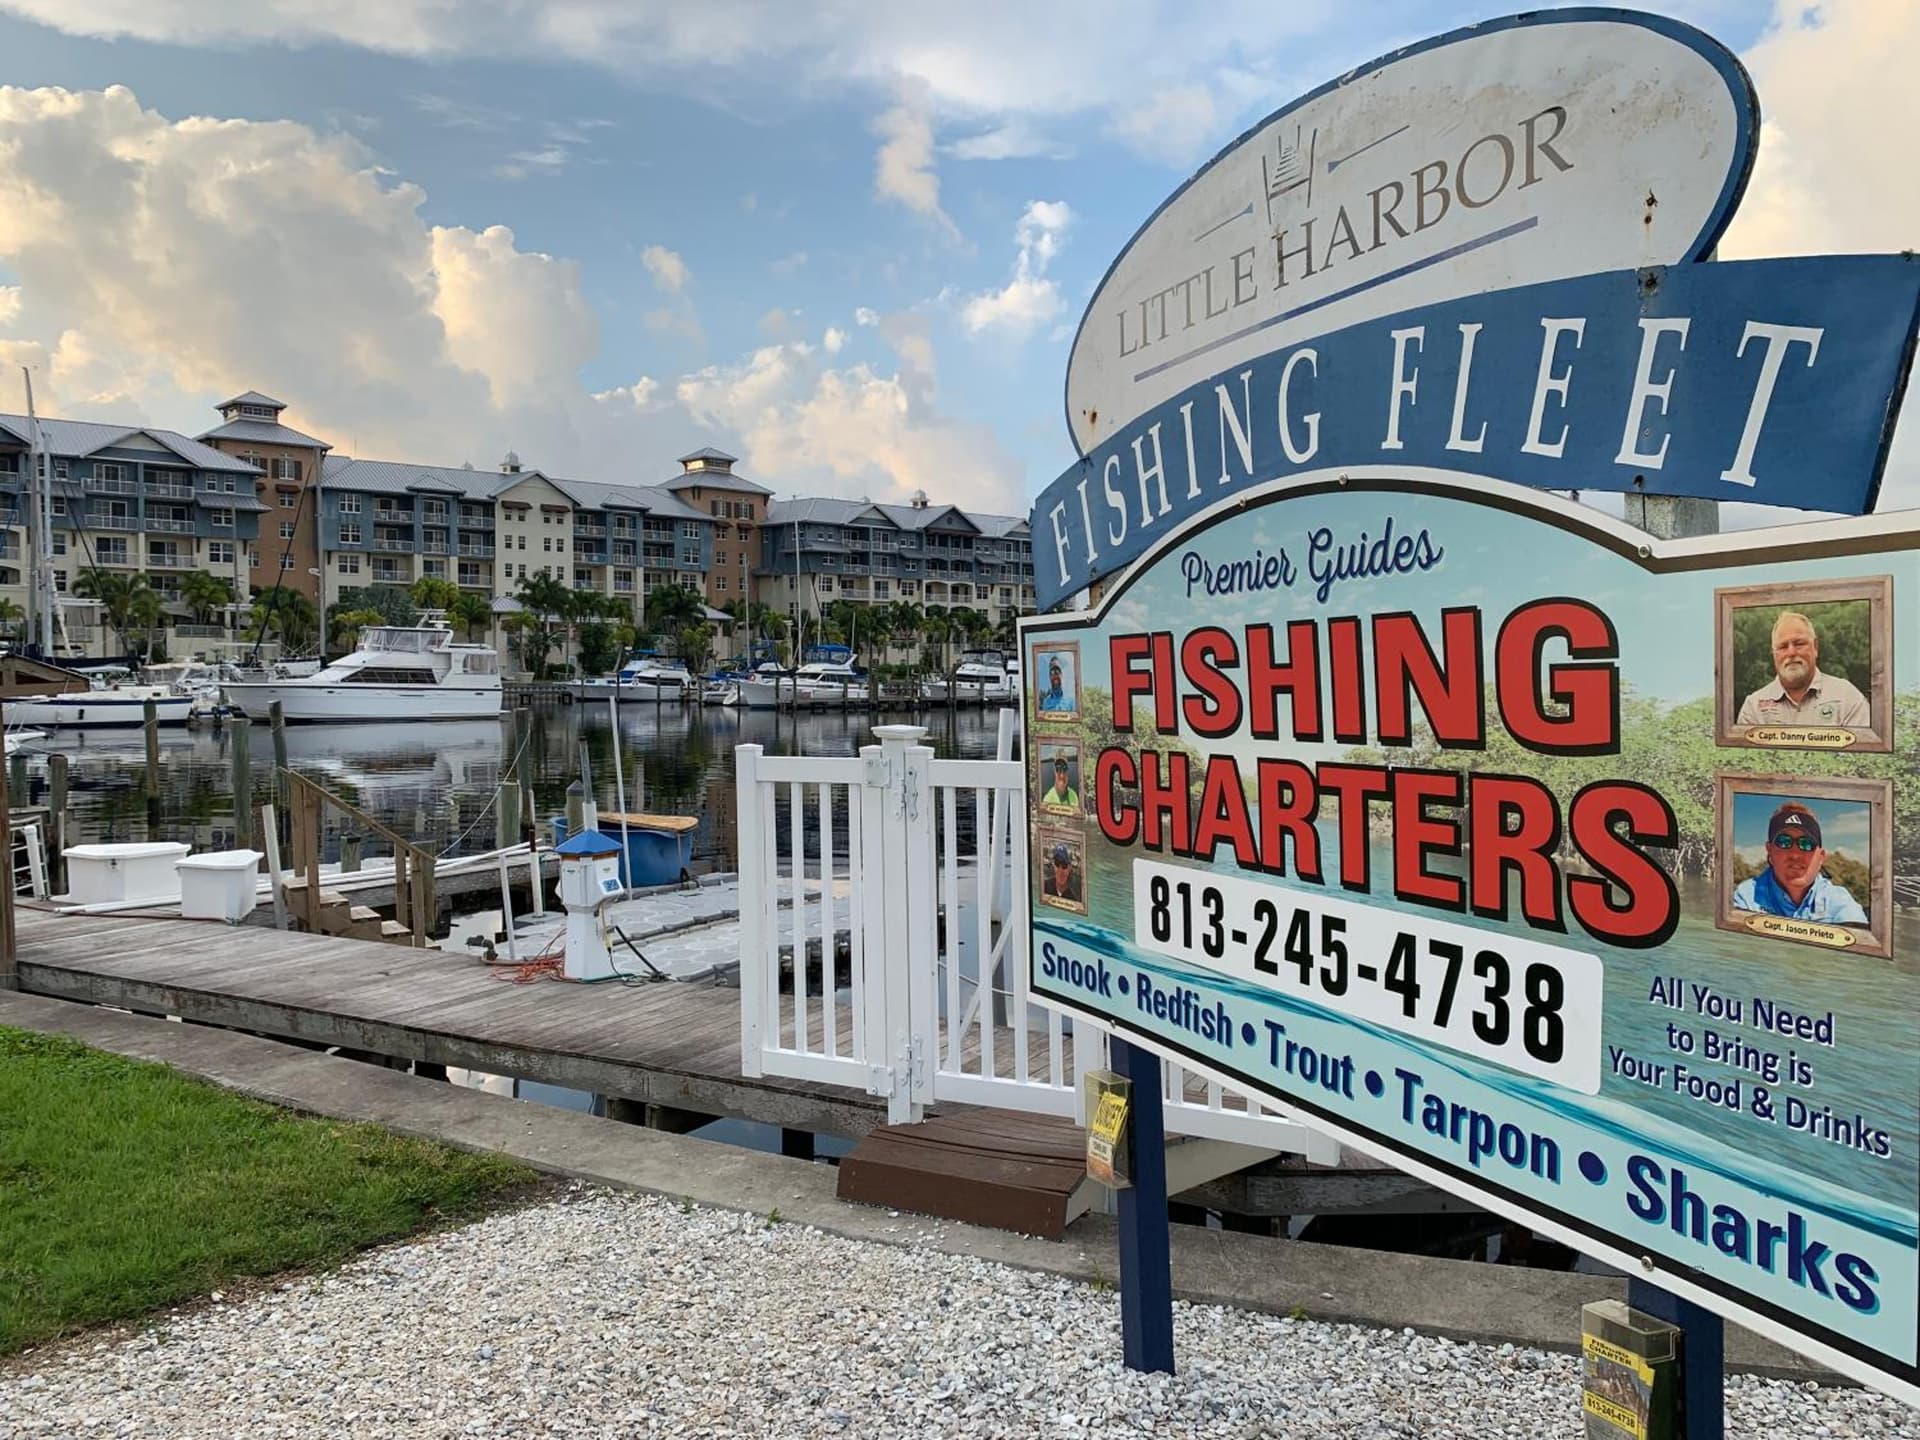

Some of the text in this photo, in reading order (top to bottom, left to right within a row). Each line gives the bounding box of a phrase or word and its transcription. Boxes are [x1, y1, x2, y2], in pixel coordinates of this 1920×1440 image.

[1117, 105, 1575, 359] LITTLE HARBOR
[1049, 317, 1825, 588] FISHING FLEET
[1181, 517, 1443, 602] Premier Guides
[1109, 597, 1620, 757] FISHING
[1780, 732, 1805, 742] Danny
[1807, 732, 1841, 742] Guarino
[1095, 746, 1679, 948] CHARTERS
[1150, 875, 1565, 1064] 813-245-4738
[1785, 923, 1808, 935] Jason
[1649, 975, 1835, 1047] All You Need
[1666, 1022, 1813, 1087] to Bring is
[1041, 940, 1880, 1315] Snook Redfish Trout Tarpon Sharks
[1608, 1044, 1893, 1159] Your Food & Drinks
